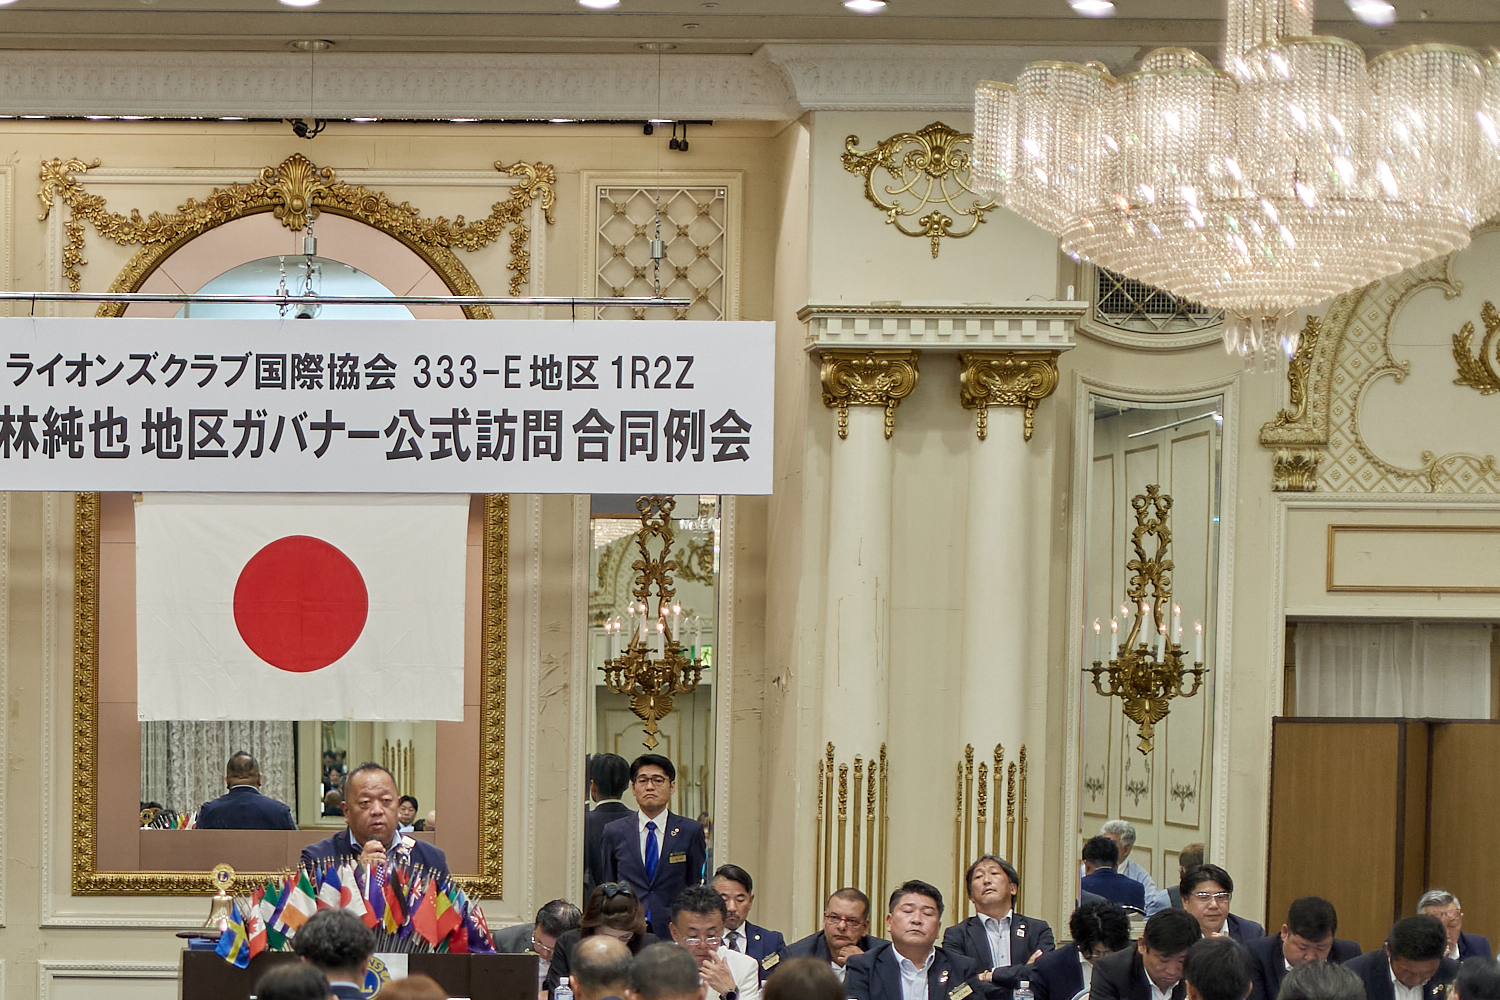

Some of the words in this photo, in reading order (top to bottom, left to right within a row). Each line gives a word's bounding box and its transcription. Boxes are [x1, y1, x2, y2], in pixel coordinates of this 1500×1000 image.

[6, 351, 398, 391] ライオンズクラブ国際協会
[611, 355, 695, 390] 1R2Z
